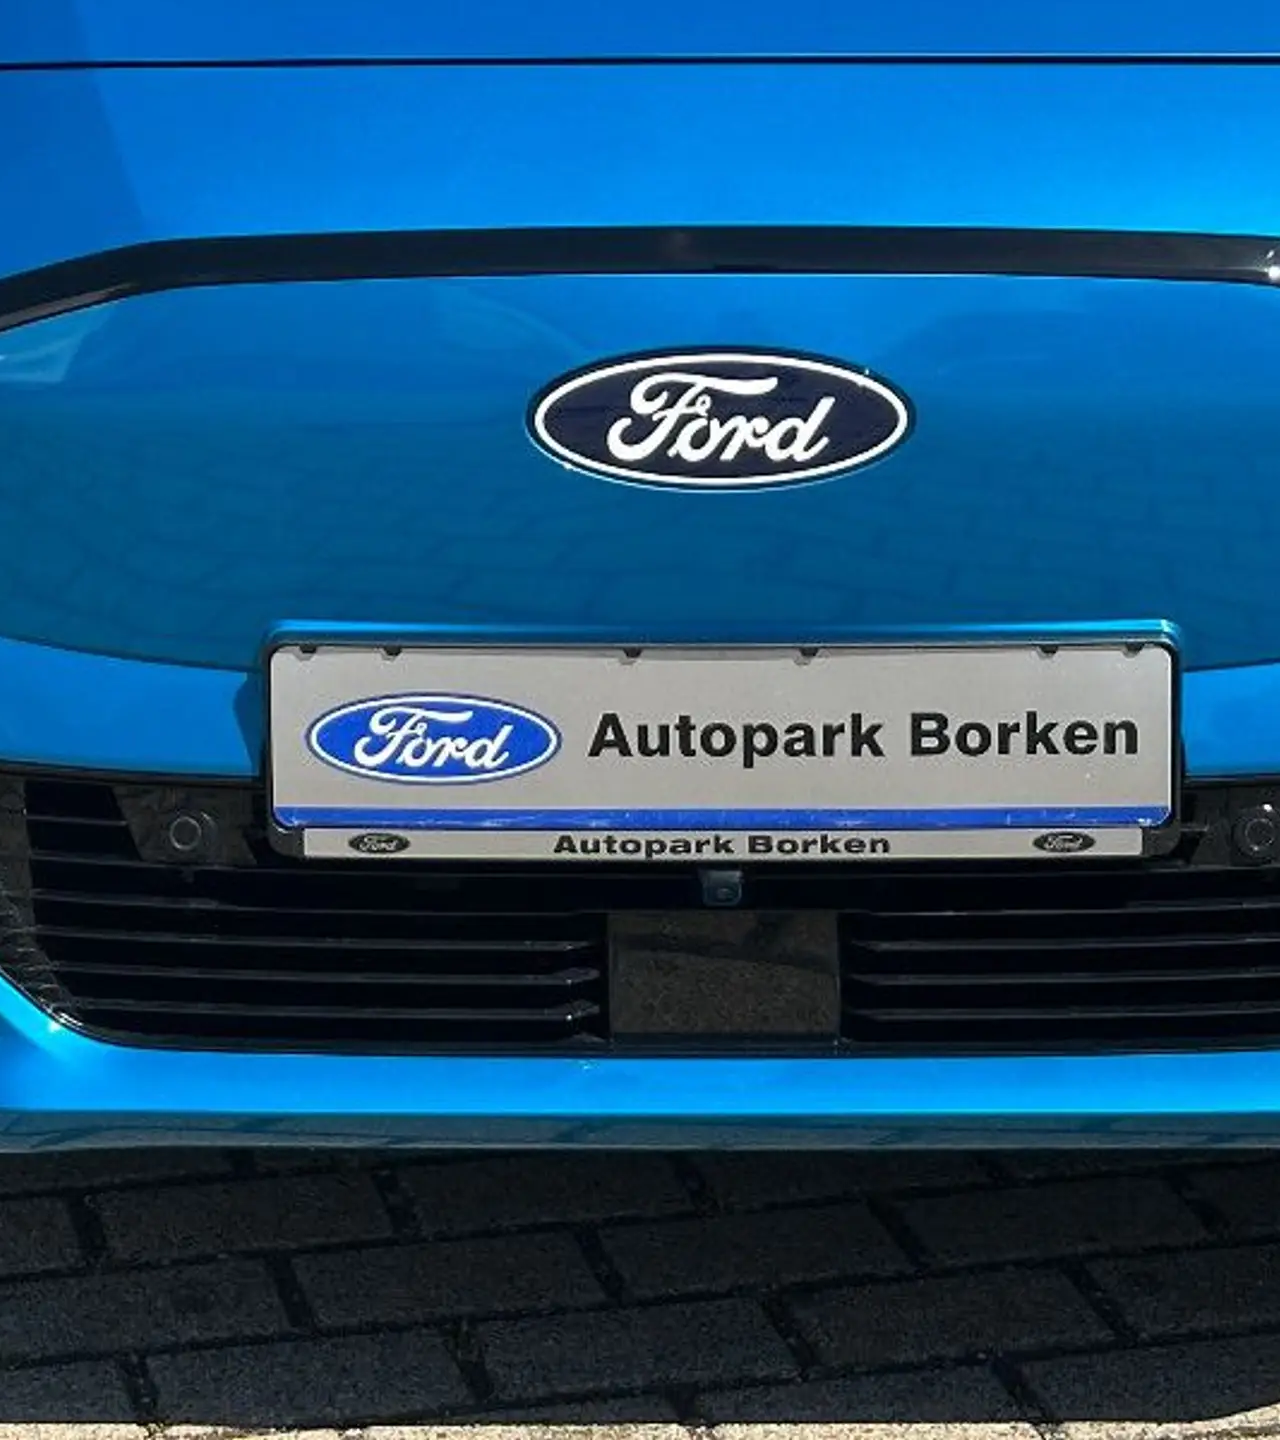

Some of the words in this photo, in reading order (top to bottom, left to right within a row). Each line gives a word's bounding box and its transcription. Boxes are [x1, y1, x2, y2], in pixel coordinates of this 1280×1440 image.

[587, 712, 886, 768] Autopark
[909, 710, 1139, 756] Borken
[553, 835, 735, 858] Autopark
[748, 834, 891, 854] Borken
